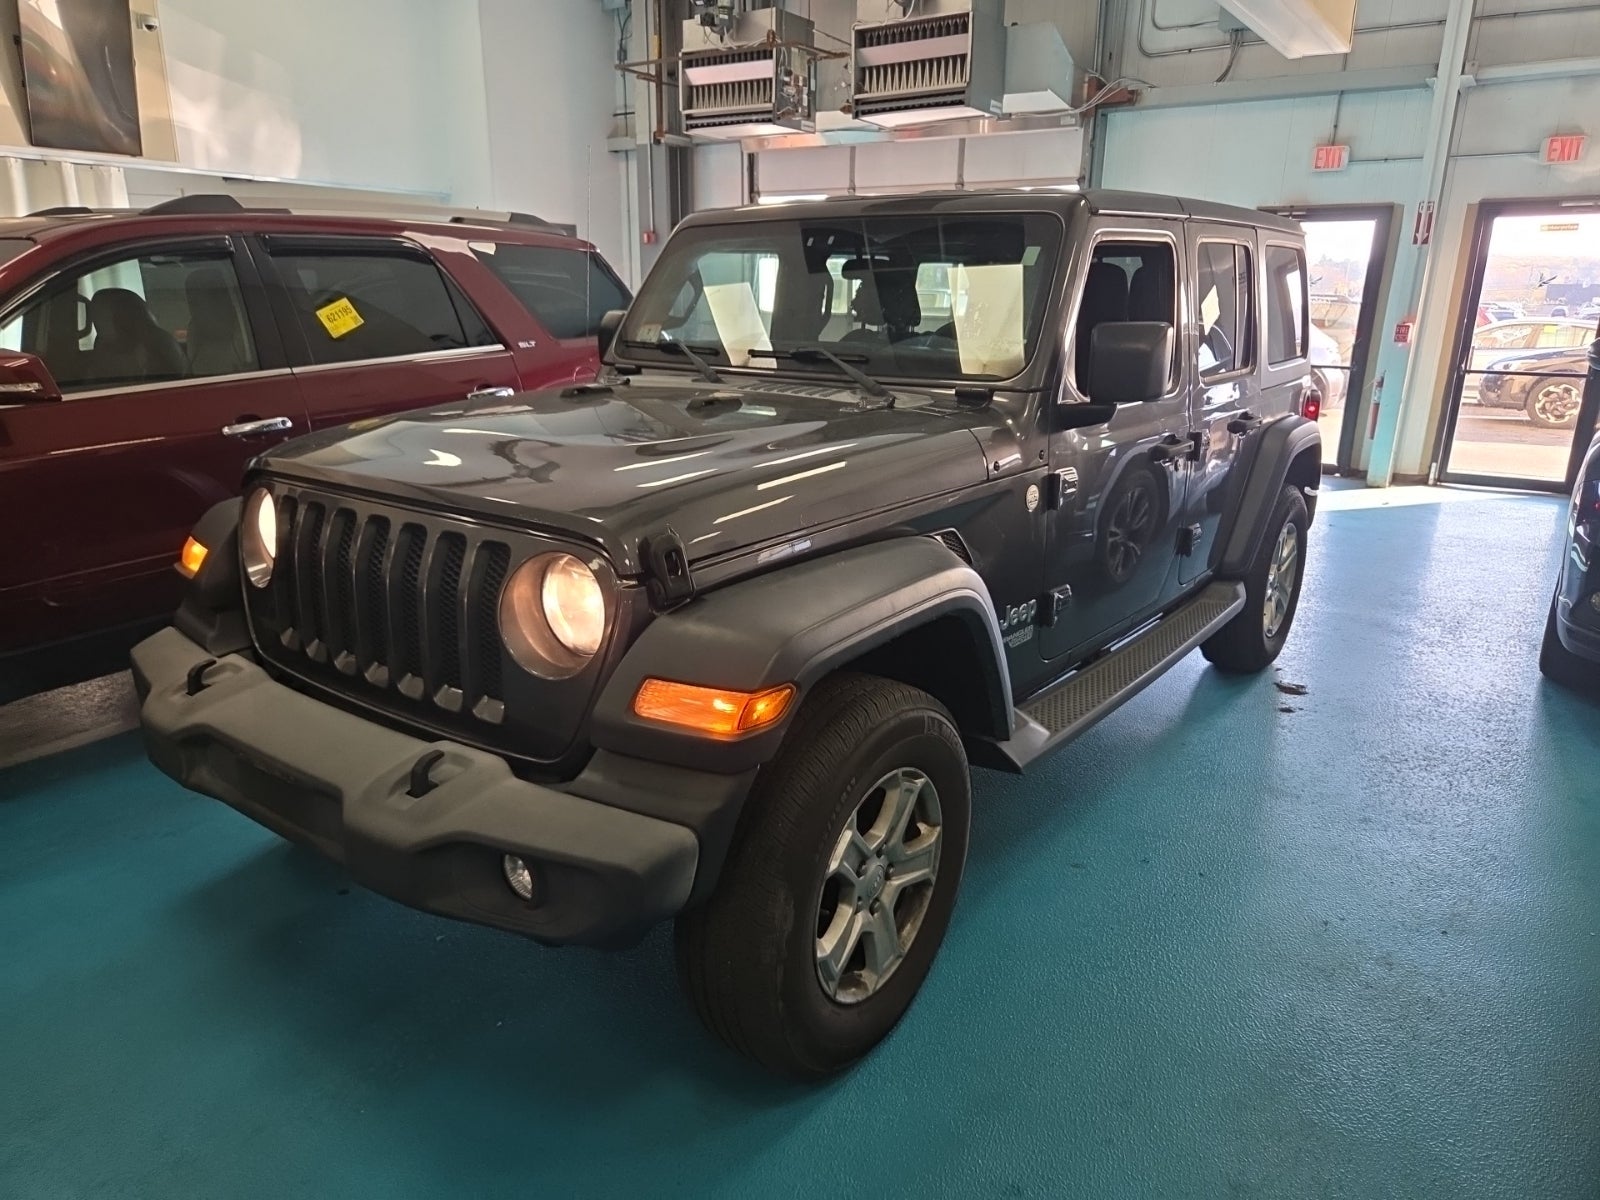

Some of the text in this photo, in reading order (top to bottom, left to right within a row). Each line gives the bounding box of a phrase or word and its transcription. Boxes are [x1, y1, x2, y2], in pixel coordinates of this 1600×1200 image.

[1315, 147, 1345, 169] EXIT
[1547, 136, 1584, 162] EXIT
[1000, 599, 1036, 630] Jeep
